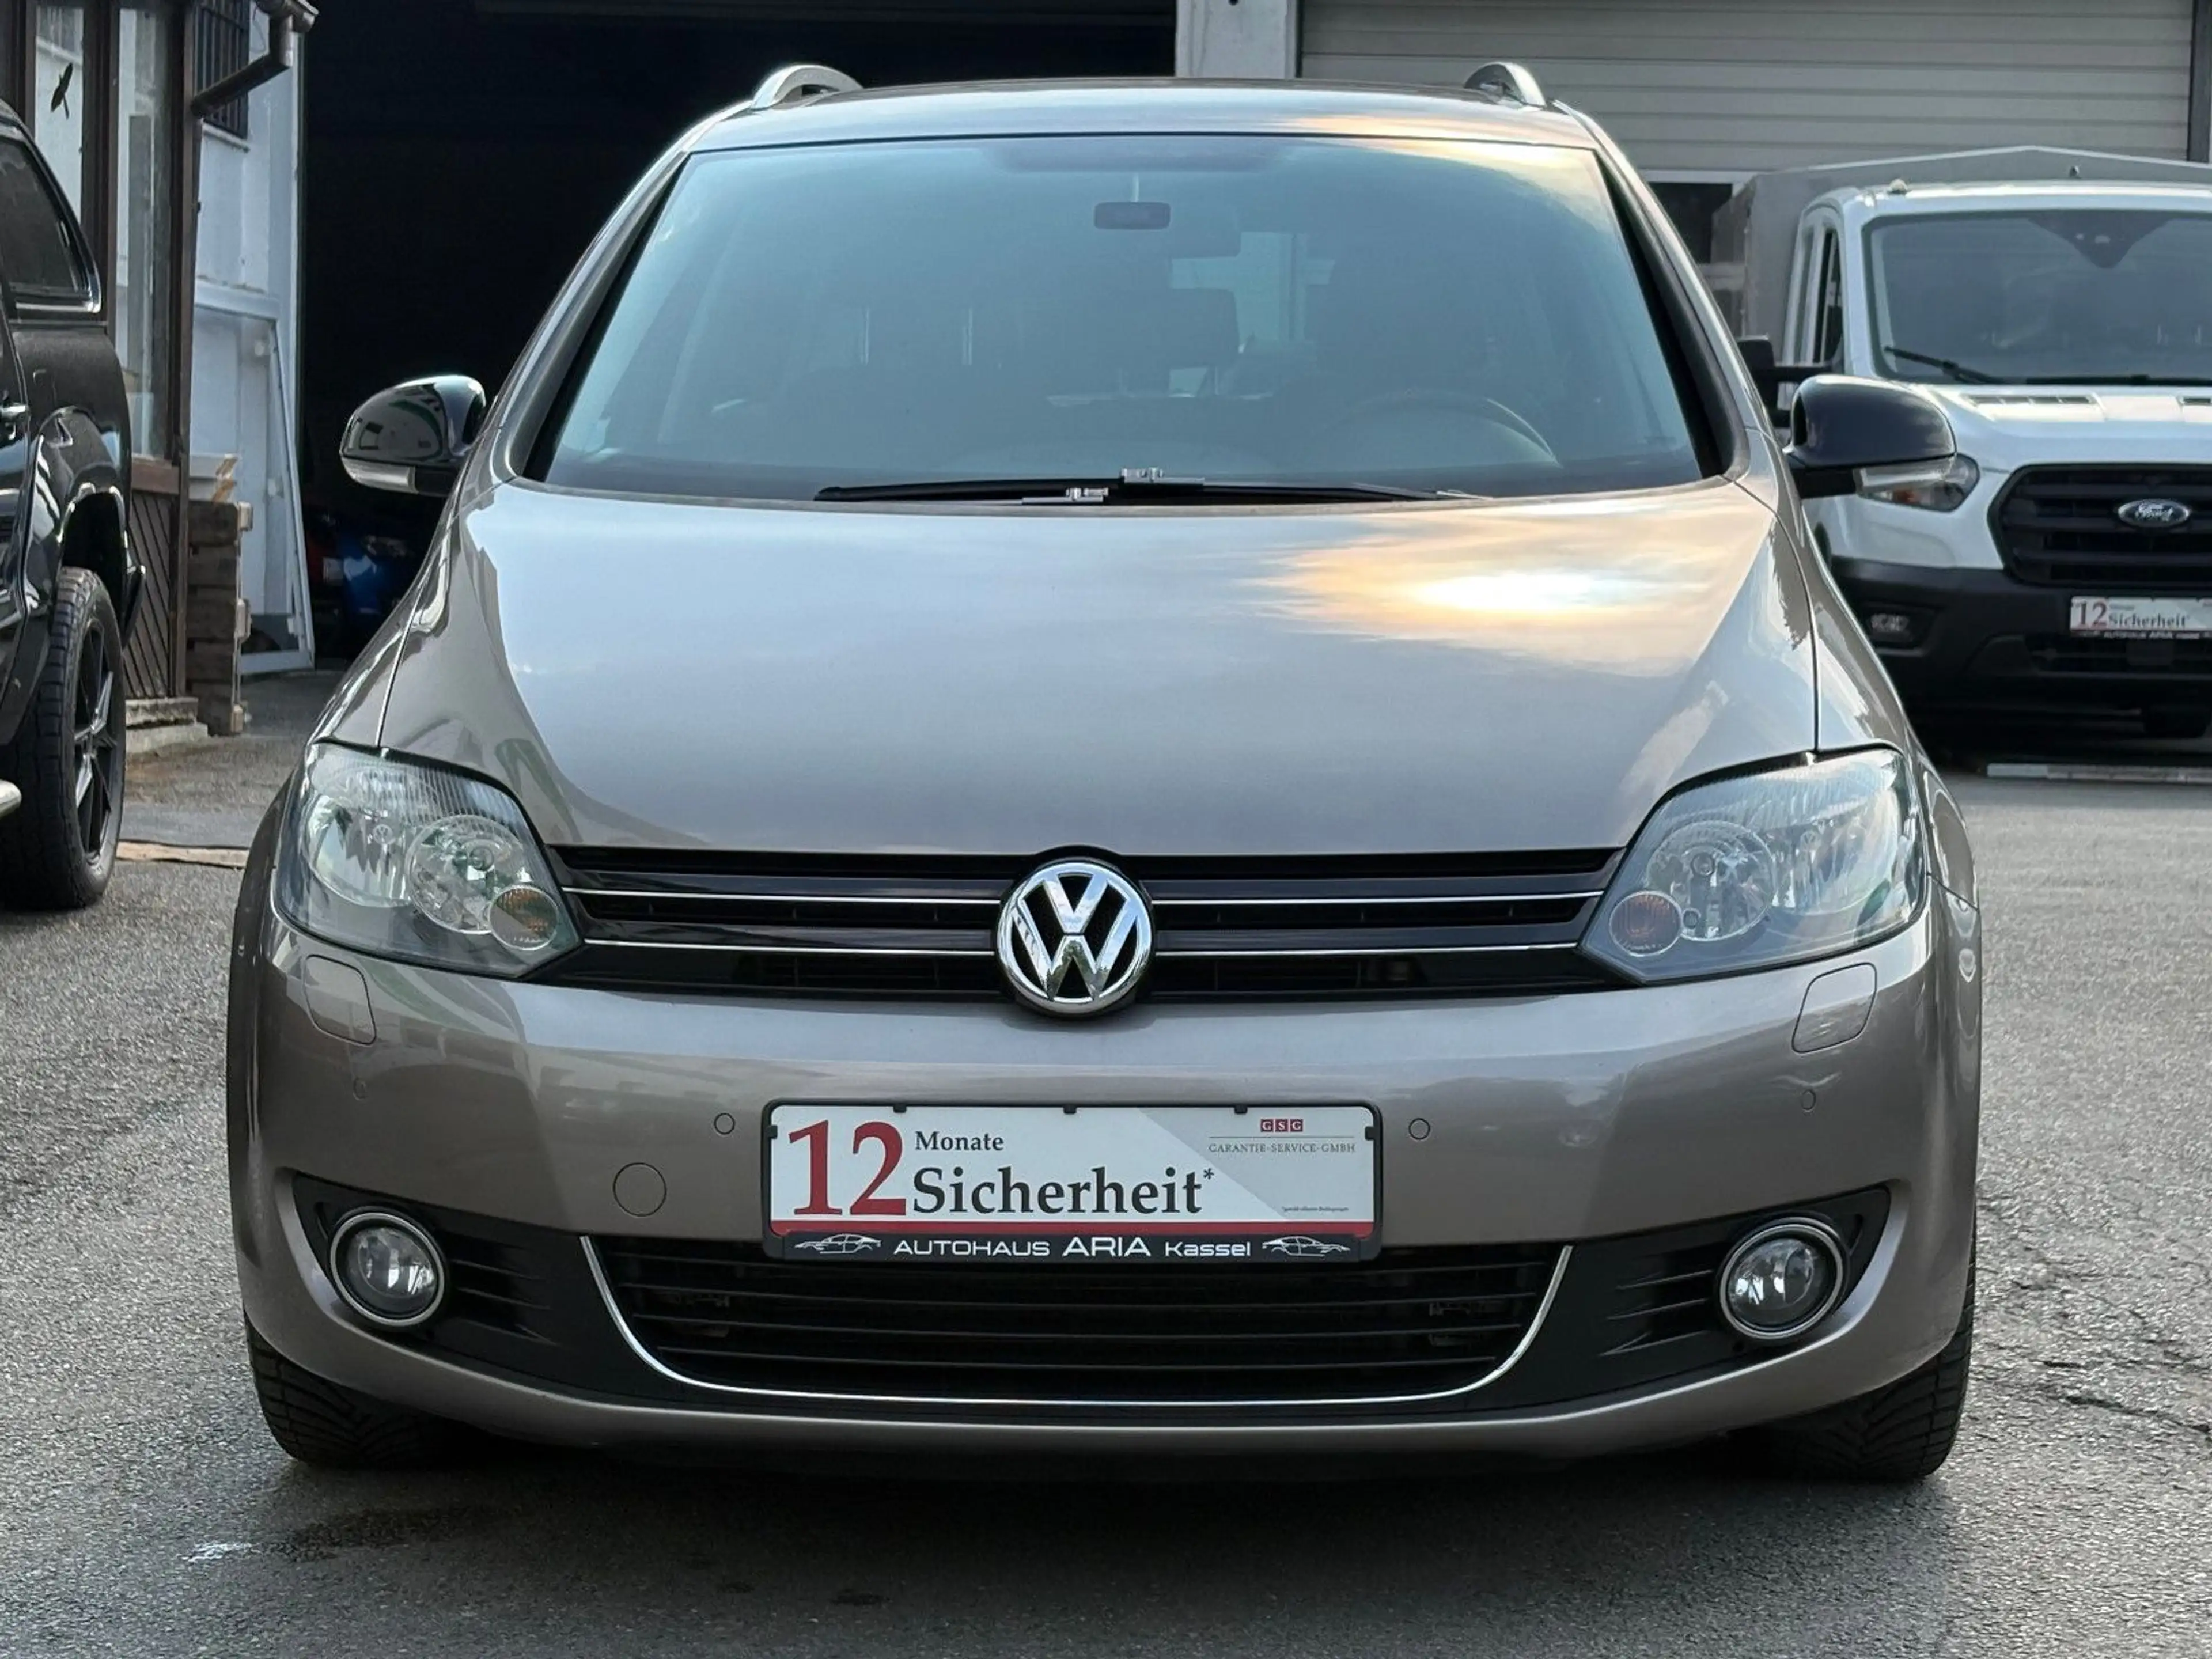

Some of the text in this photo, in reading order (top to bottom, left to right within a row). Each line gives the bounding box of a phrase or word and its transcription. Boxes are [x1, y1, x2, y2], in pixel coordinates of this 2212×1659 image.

[2076, 601, 2108, 627] 12
[1003, 863, 1145, 1008] VW
[1261, 1119, 1303, 1132] GSG
[915, 1131, 1004, 1151] Monate
[788, 1119, 907, 1216] 12
[893, 1237, 1251, 1257] AUTOHAUS ARIA Kassel
